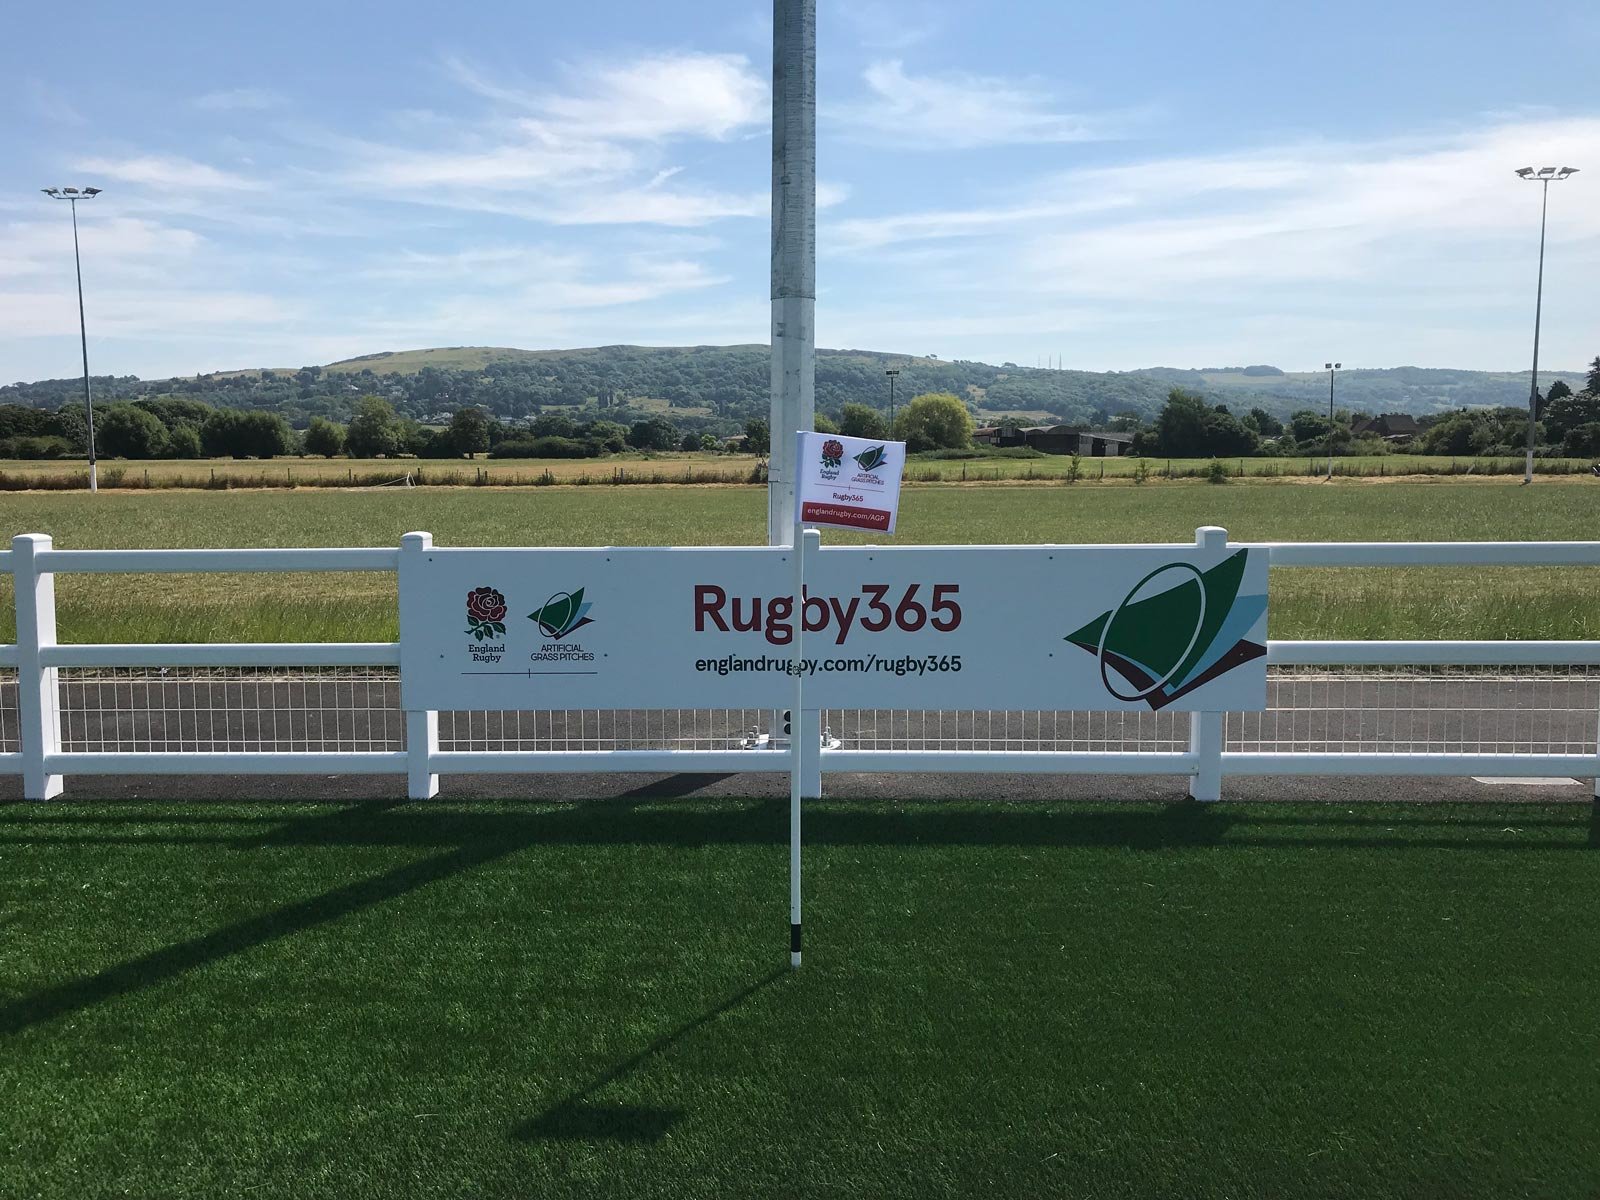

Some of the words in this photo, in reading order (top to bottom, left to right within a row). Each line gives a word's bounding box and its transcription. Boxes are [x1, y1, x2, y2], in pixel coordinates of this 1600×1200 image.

[833, 493, 863, 501] Rugby365
[807, 508, 885, 521] englandrugby.com/AGP
[694, 584, 962, 645] Rugby365
[468, 644, 505, 654] England
[541, 644, 584, 652] ARTIFICIAL
[473, 653, 501, 663] Rugby
[530, 653, 558, 661] GRASS
[560, 653, 595, 661] PITCHES
